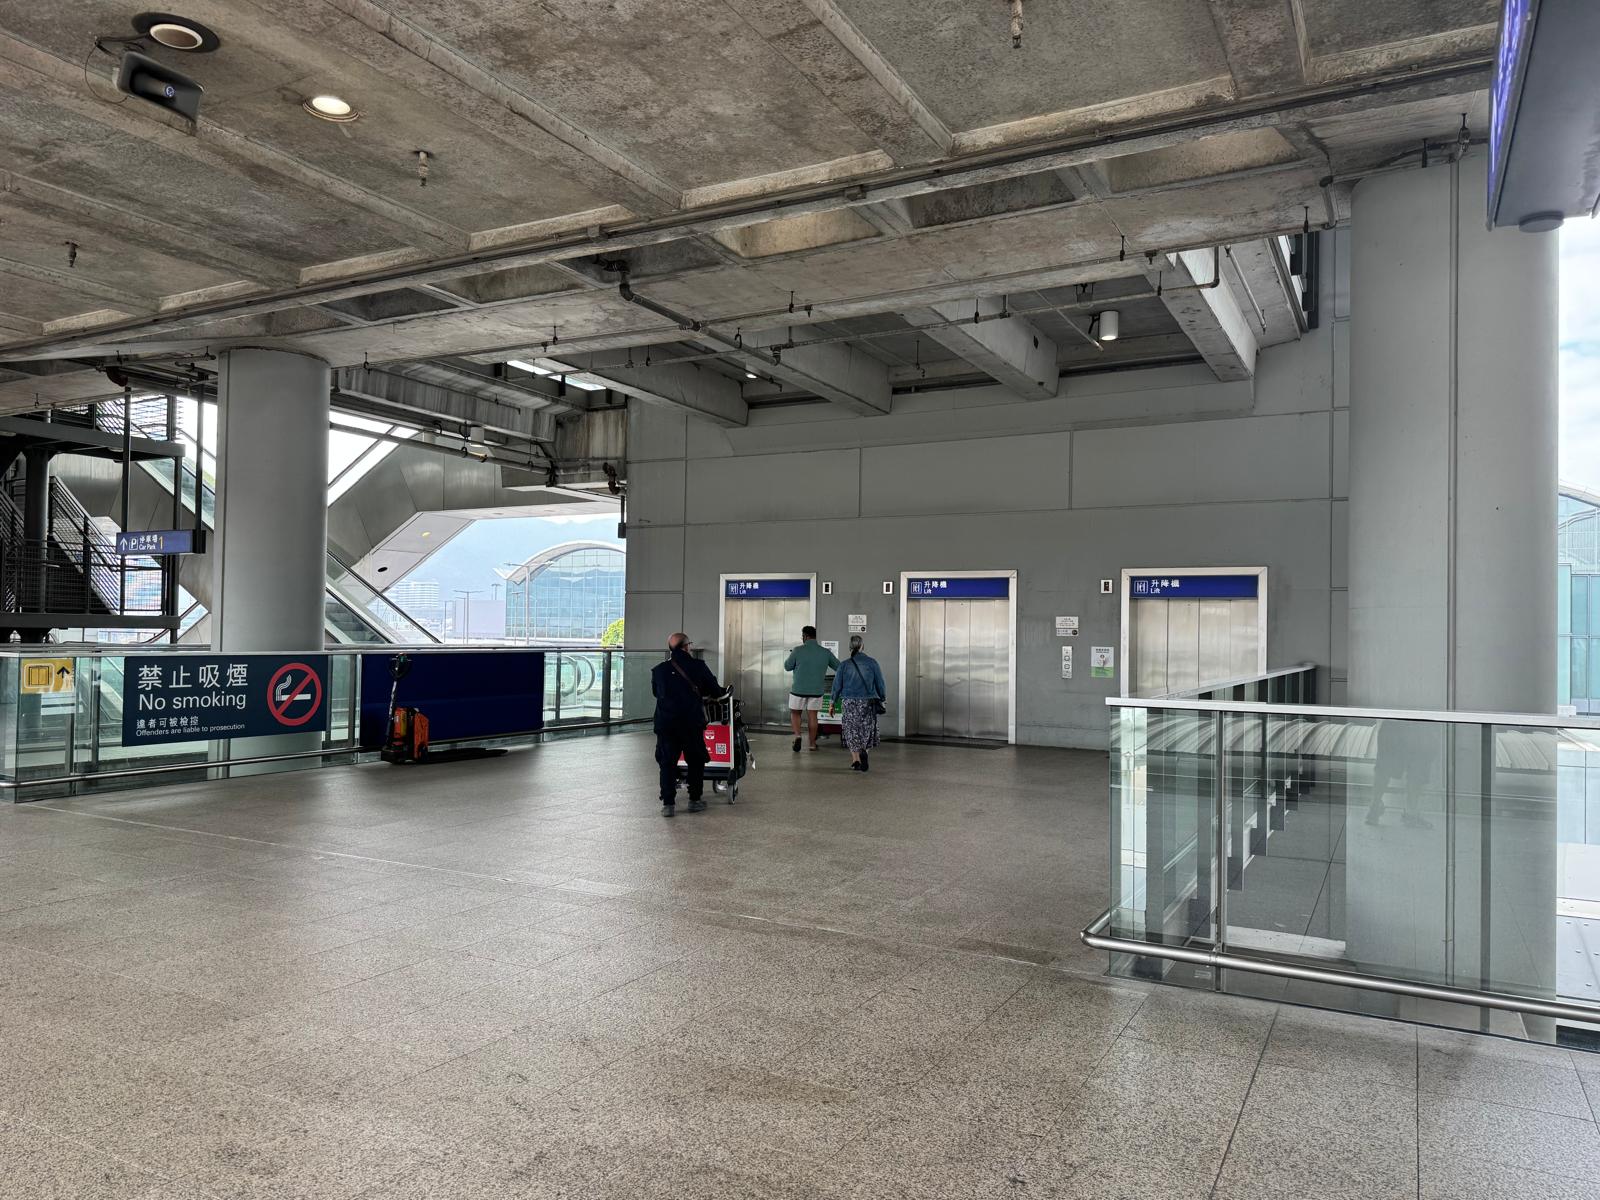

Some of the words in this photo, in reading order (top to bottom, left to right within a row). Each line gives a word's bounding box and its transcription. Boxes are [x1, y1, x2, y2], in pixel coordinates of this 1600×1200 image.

[130, 538, 136, 548] P
[158, 536, 163, 550] 1
[1150, 580, 1180, 588] 升降機
[138, 664, 248, 690] 禁止吸煙
[139, 694, 166, 710] No
[172, 691, 246, 709] smoking
[136, 716, 199, 729] 違者可被檢控
[136, 728, 169, 736] Offenders
[209, 723, 245, 732] prosecution
